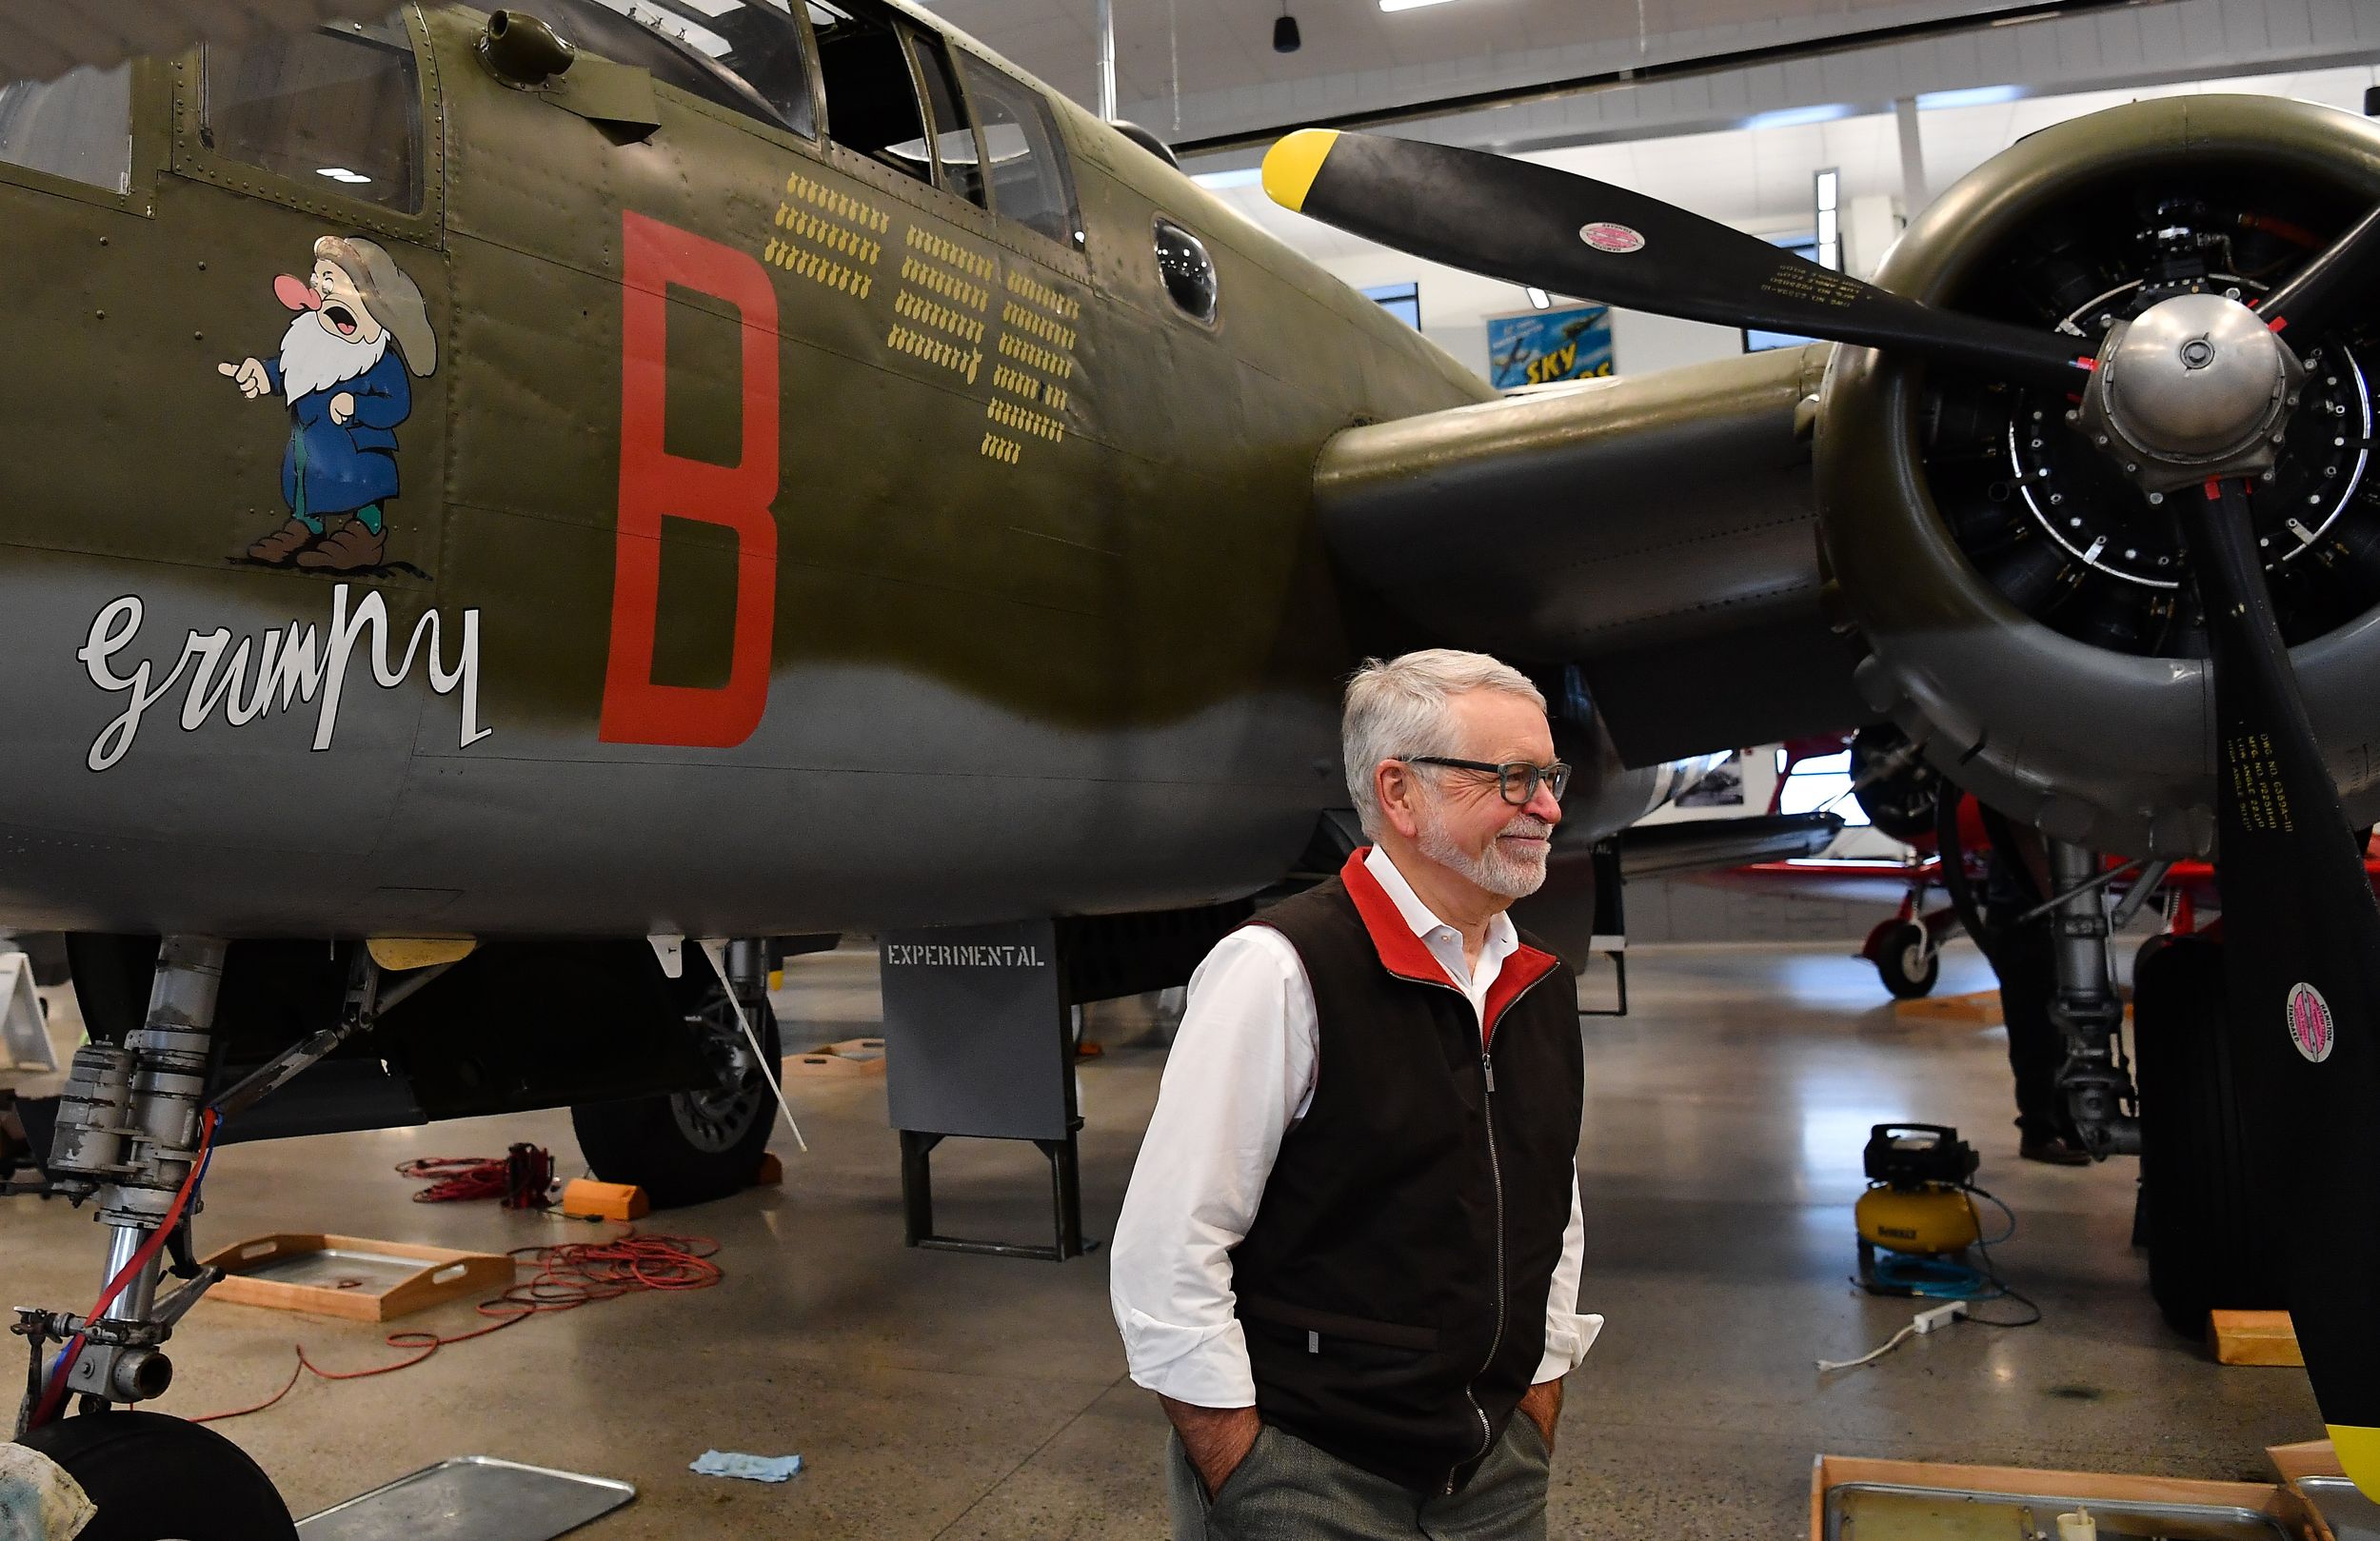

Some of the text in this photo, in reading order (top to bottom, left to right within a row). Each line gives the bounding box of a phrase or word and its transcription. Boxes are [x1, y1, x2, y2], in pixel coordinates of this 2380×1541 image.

[1526, 341, 1577, 385] SKY
[599, 208, 779, 748] B
[888, 944, 1044, 966] EXPERIMENTAL
[2288, 1004, 2300, 1042] STANDARD
[2319, 1003, 2332, 1041] HAMILTON
